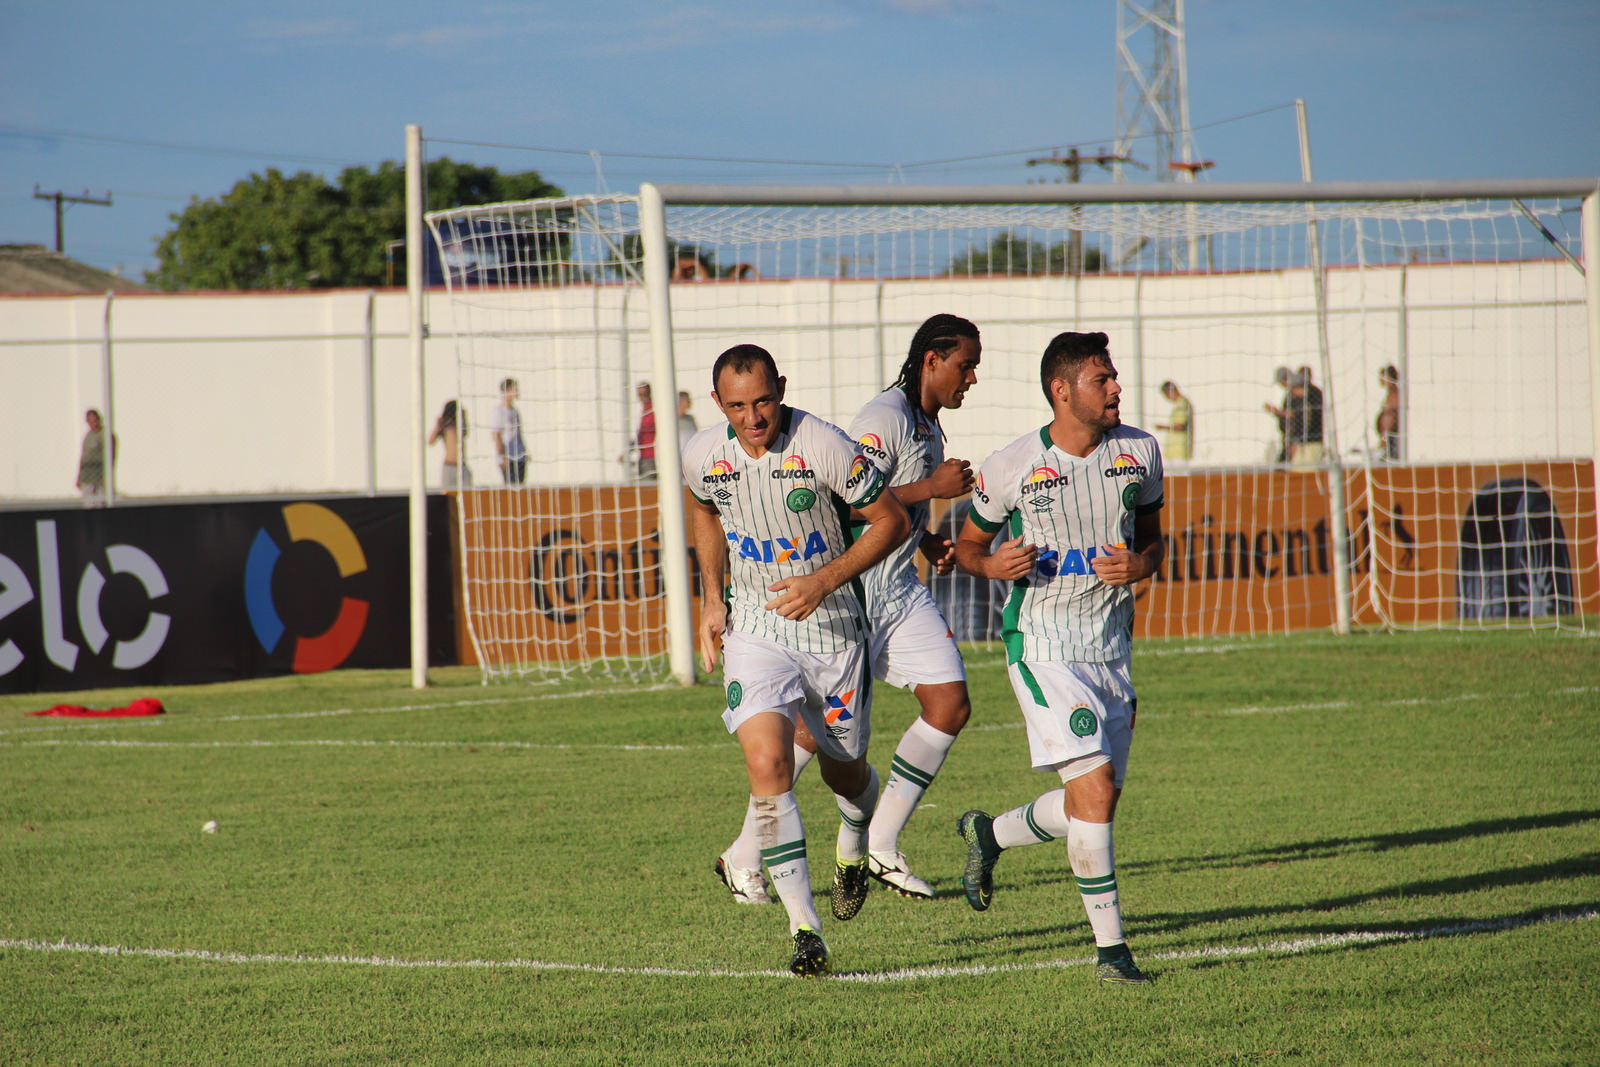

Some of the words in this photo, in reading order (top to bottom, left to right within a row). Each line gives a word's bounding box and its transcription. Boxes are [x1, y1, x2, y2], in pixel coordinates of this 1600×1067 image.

[854, 440, 887, 460] rora
[703, 471, 741, 483] aurora
[771, 468, 815, 479] aurora
[1104, 464, 1147, 478] aurora
[1020, 475, 1069, 495] aurora
[975, 486, 990, 504] ora
